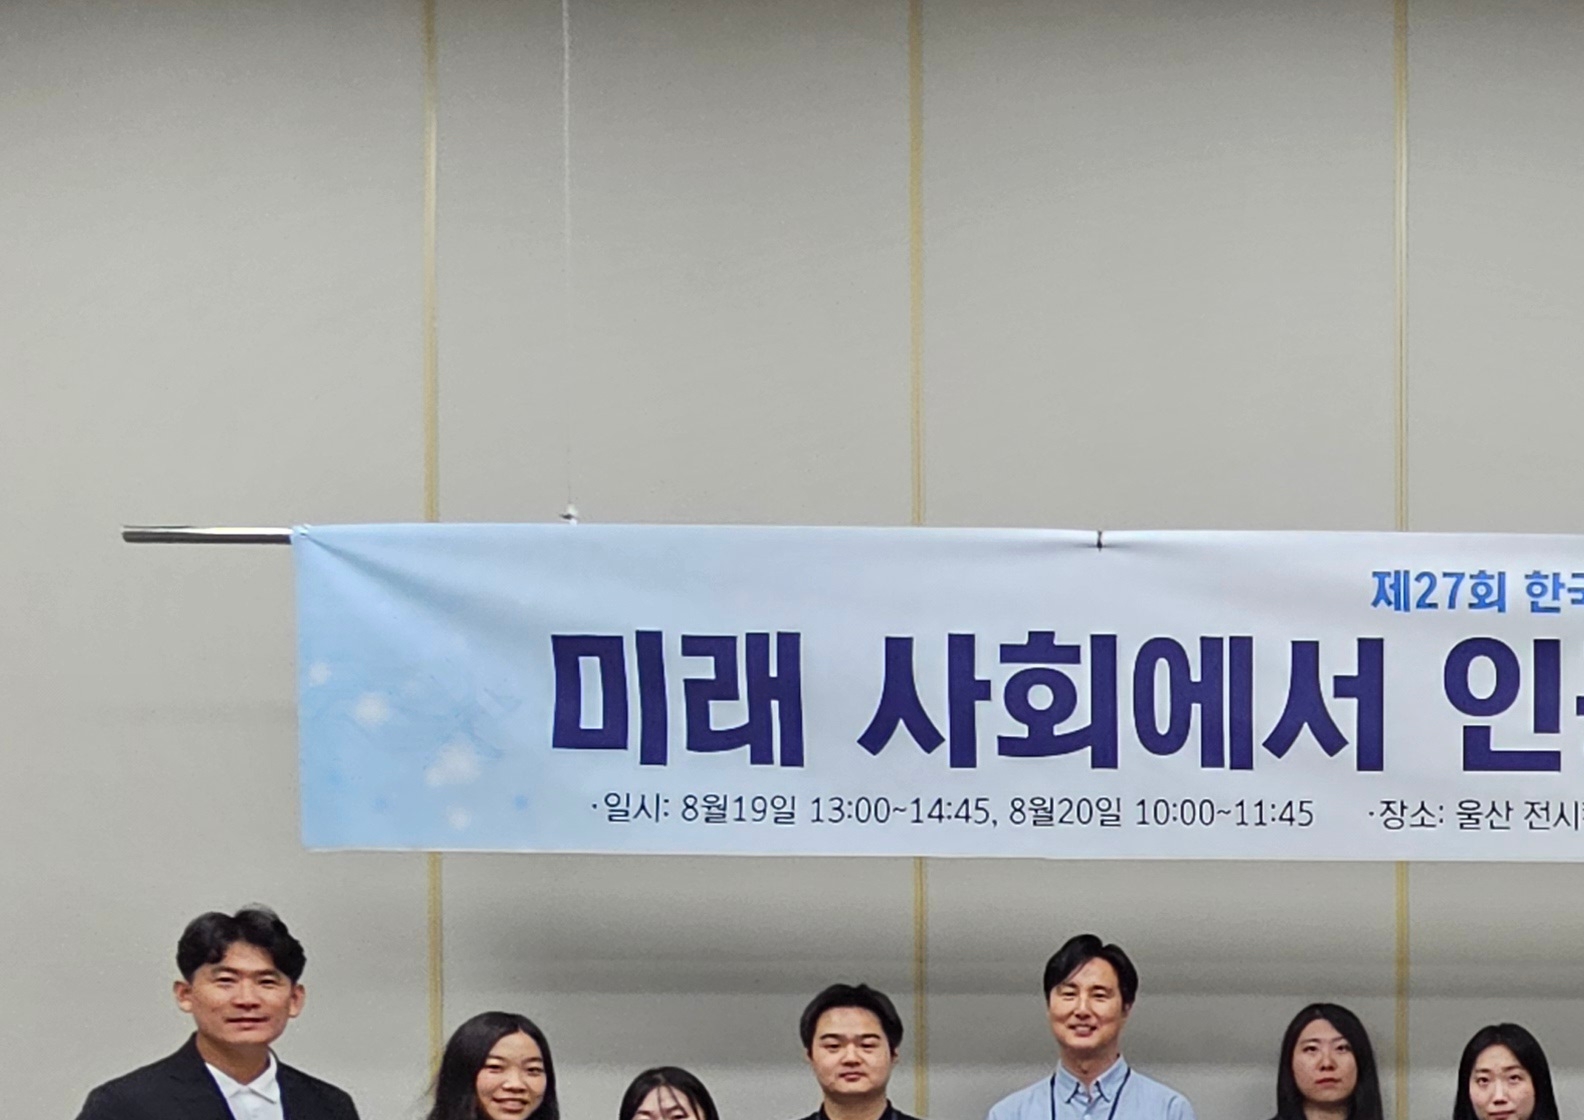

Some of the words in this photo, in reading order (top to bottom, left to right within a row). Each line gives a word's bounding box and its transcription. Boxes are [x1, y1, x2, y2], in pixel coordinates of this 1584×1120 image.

[1370, 569, 1507, 614] 제27회
[550, 629, 804, 768] 미래
[856, 630, 1385, 772] 사회에서
[681, 794, 796, 825] 8월19일
[811, 796, 998, 828] 13:00~14:45,
[1009, 796, 1122, 828] 8월20일
[1136, 798, 1314, 828] 10:00~11:45
[1456, 799, 1514, 831] 울산
